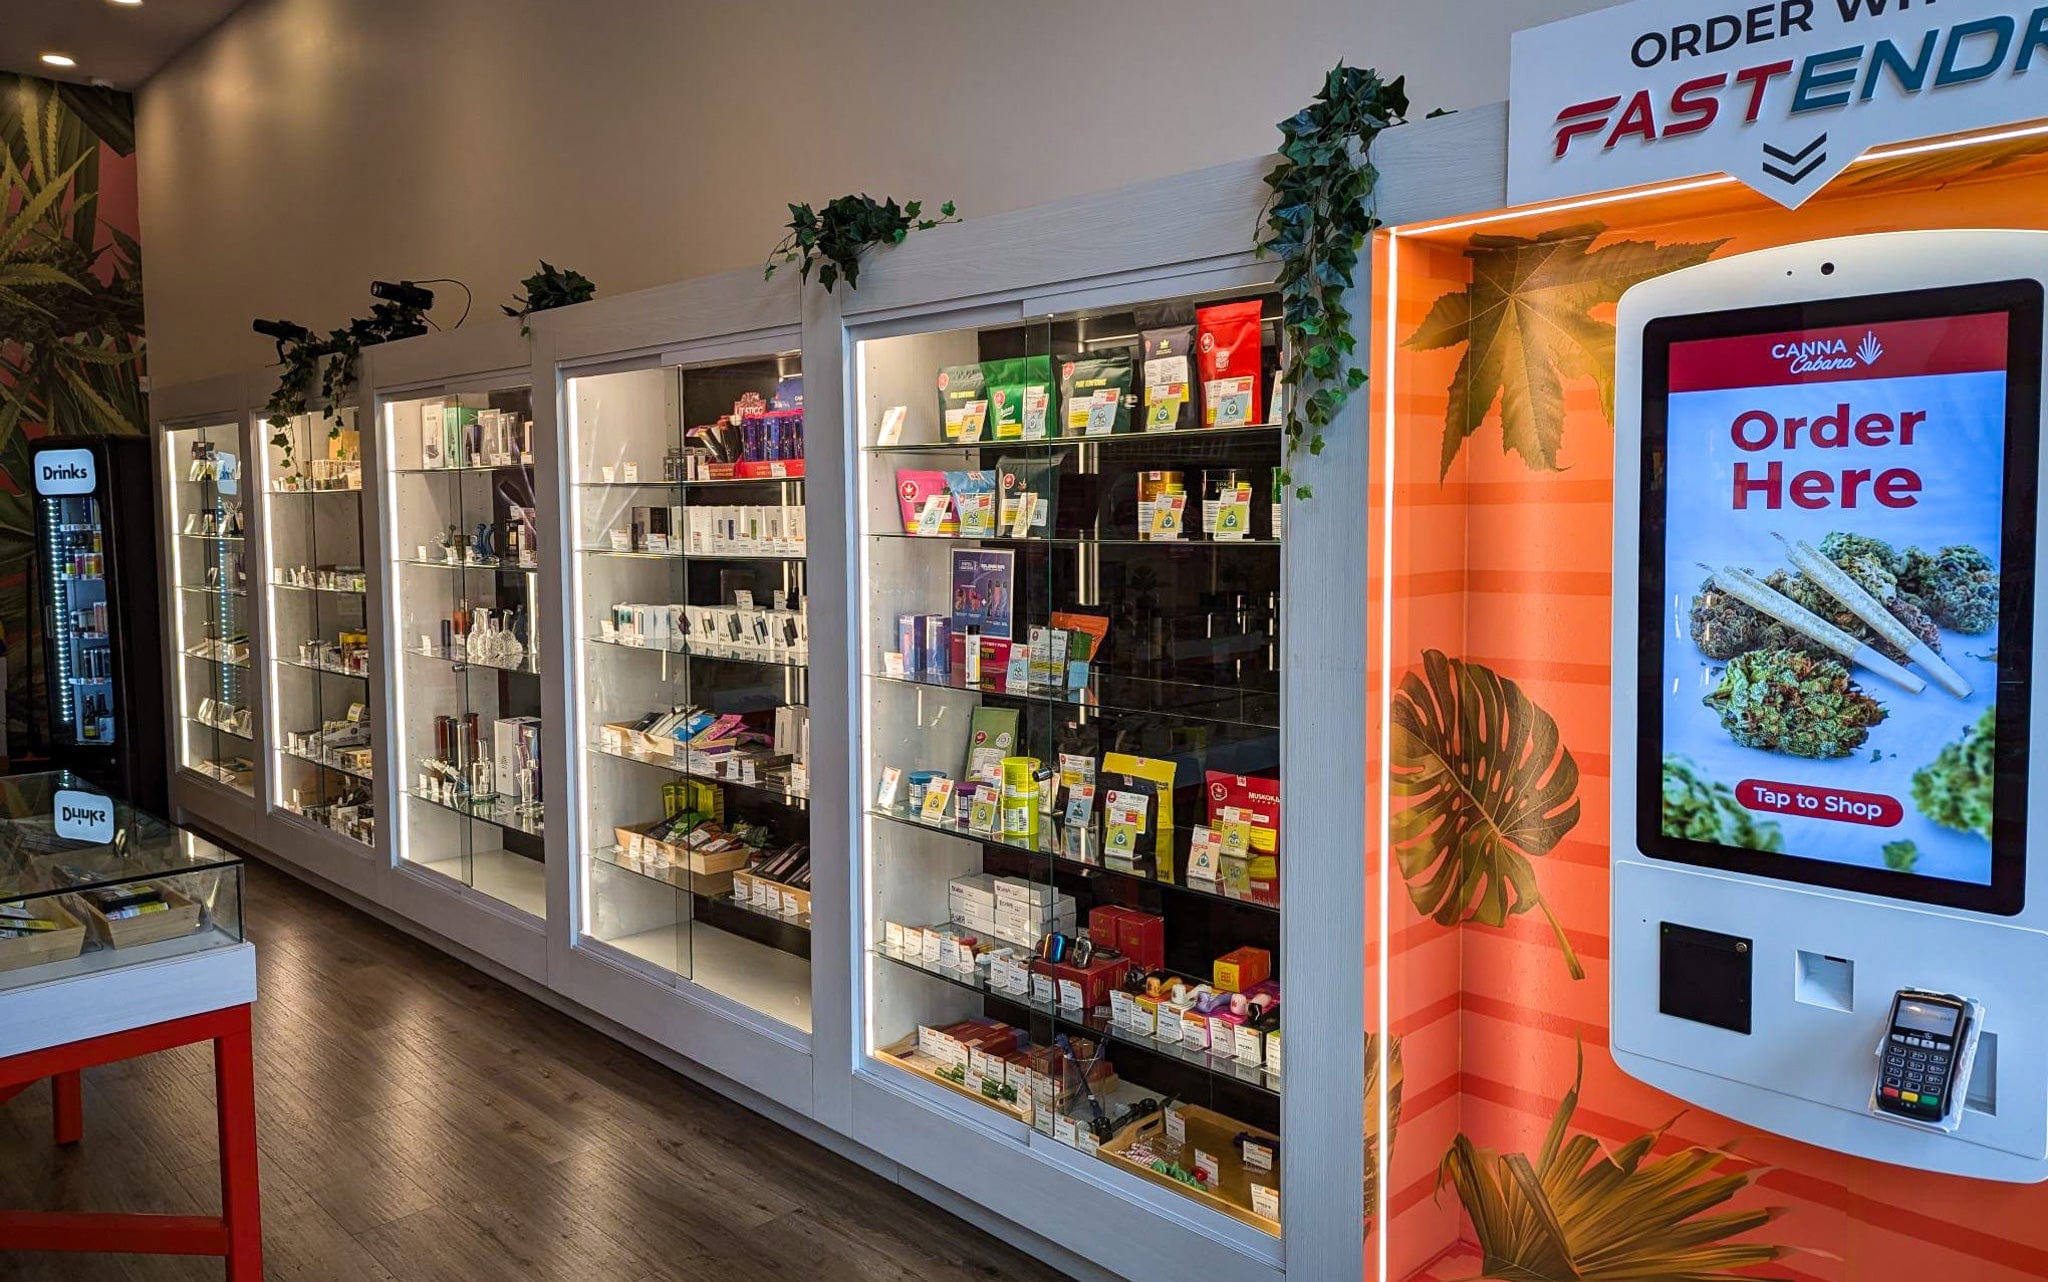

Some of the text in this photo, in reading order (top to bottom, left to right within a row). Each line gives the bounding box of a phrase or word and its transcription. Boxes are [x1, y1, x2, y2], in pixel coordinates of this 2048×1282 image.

[1630, 0, 1812, 68] ORDER
[1771, 339, 1848, 360] CANNA
[1790, 353, 1857, 374] Cabana
[1731, 403, 1927, 452] Order
[43, 463, 88, 481] Drinks
[1732, 461, 1923, 510] Here
[1752, 786, 1883, 820] Tap to Shop
